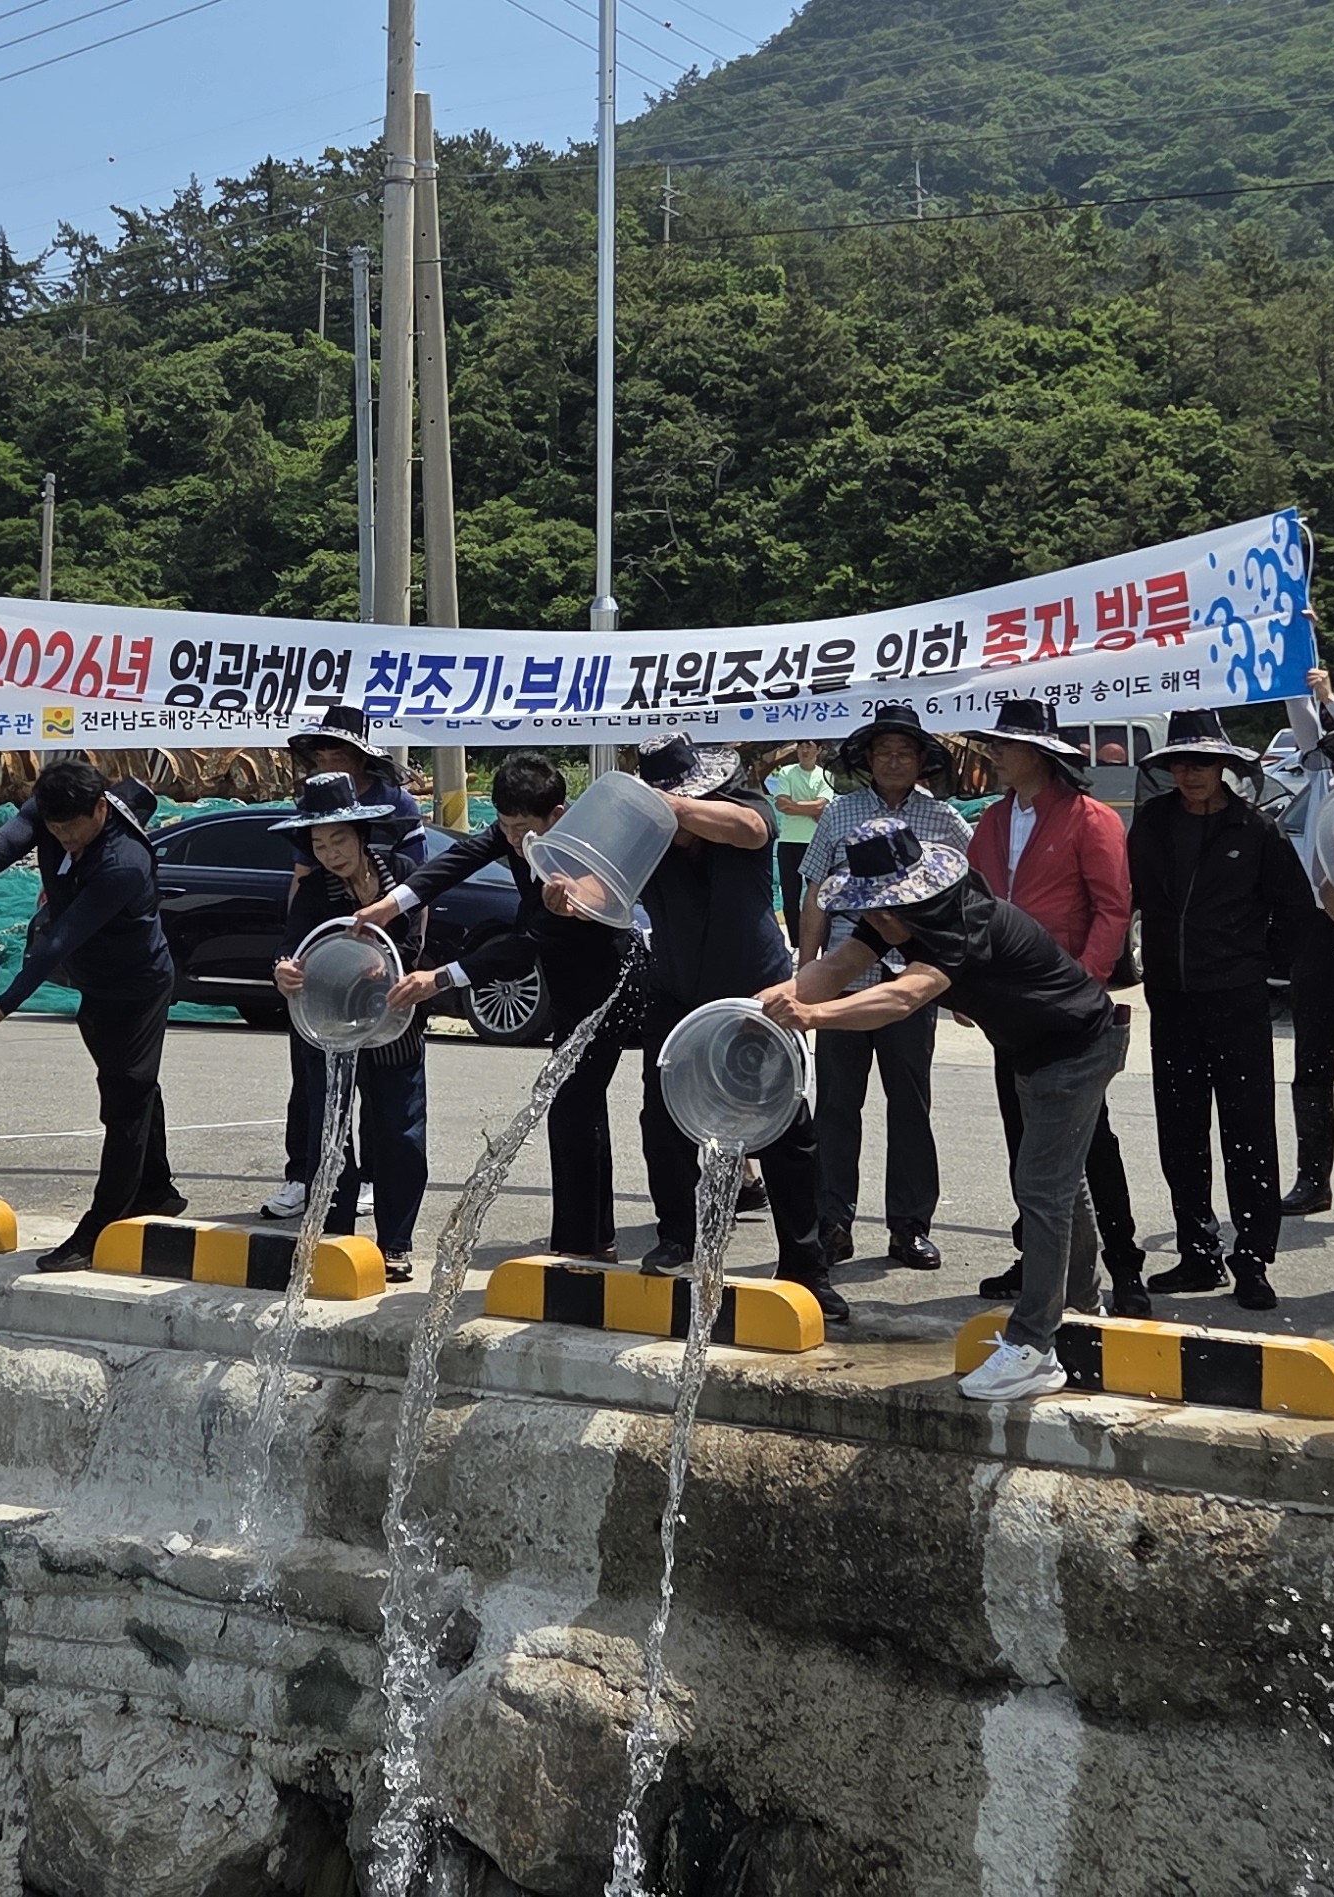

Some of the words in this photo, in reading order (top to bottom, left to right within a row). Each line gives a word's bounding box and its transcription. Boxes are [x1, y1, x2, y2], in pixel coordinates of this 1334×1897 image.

[164, 639, 353, 716] 영광해역
[362, 649, 612, 719] 참조기·부세
[620, 638, 857, 711] 자원조성을
[869, 619, 968, 682] 위한
[980, 596, 1080, 669] 종자
[1093, 570, 1192, 652] 방류
[79, 709, 291, 733] 전라남도해양수산과학원
[762, 701, 850, 723] 일자/장소
[925, 696, 943, 715] 6.
[1044, 682, 1084, 707] 영광
[1090, 675, 1152, 702] 송이도
[1160, 668, 1200, 693] 해역
